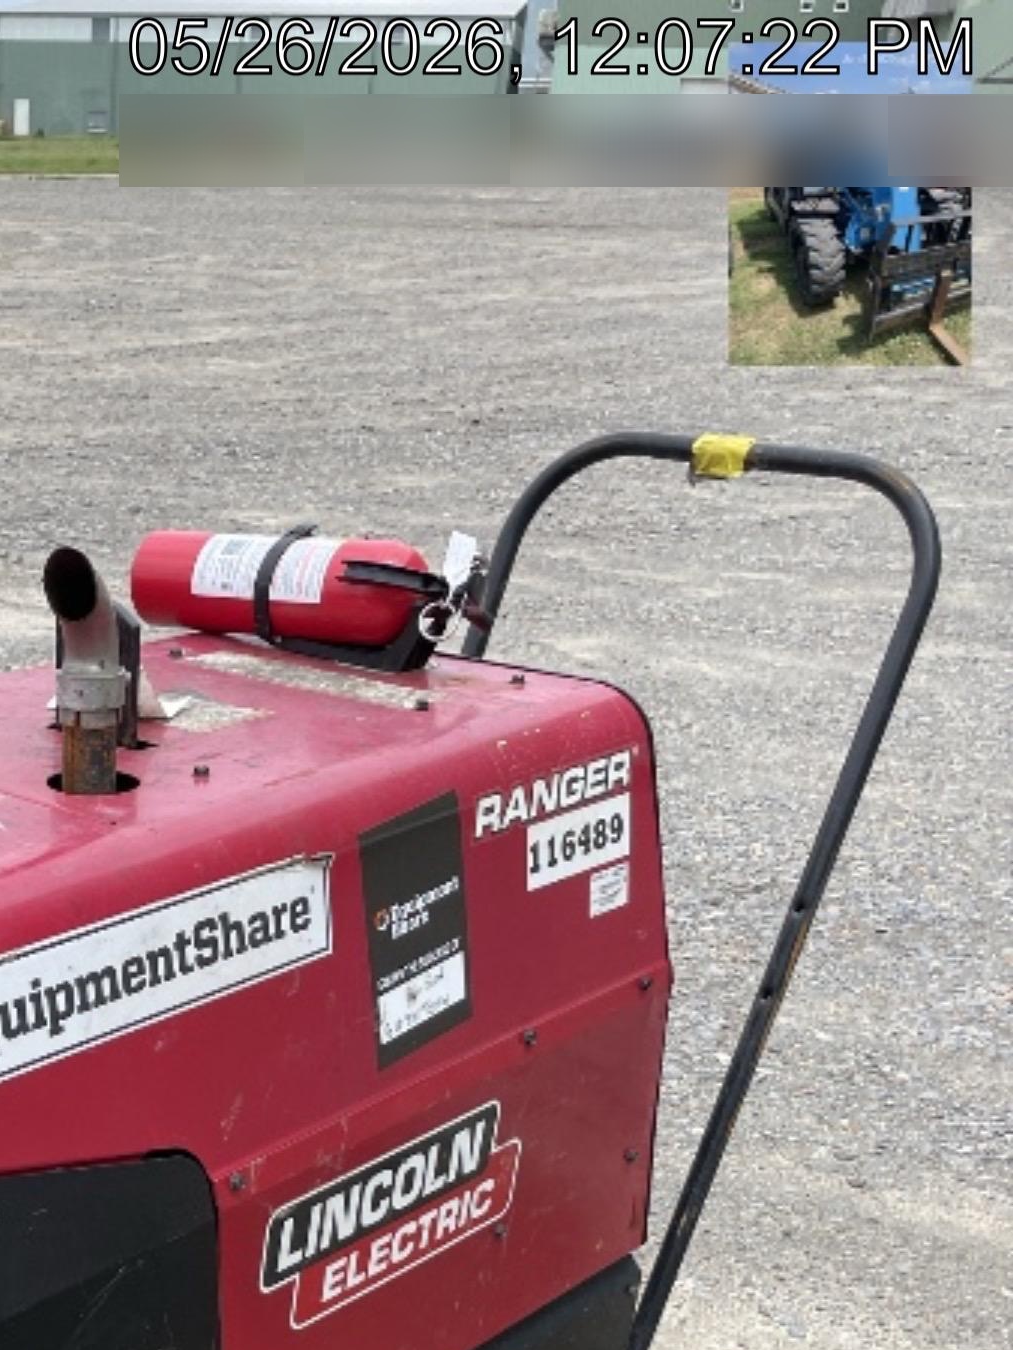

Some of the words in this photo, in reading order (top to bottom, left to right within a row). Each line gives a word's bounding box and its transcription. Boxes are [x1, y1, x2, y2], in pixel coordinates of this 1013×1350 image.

[473, 750, 631, 839] RANGER
[528, 812, 626, 874] 116489
[276, 1118, 488, 1274] LINCOLN
[319, 1177, 496, 1303] ELECTRIC
